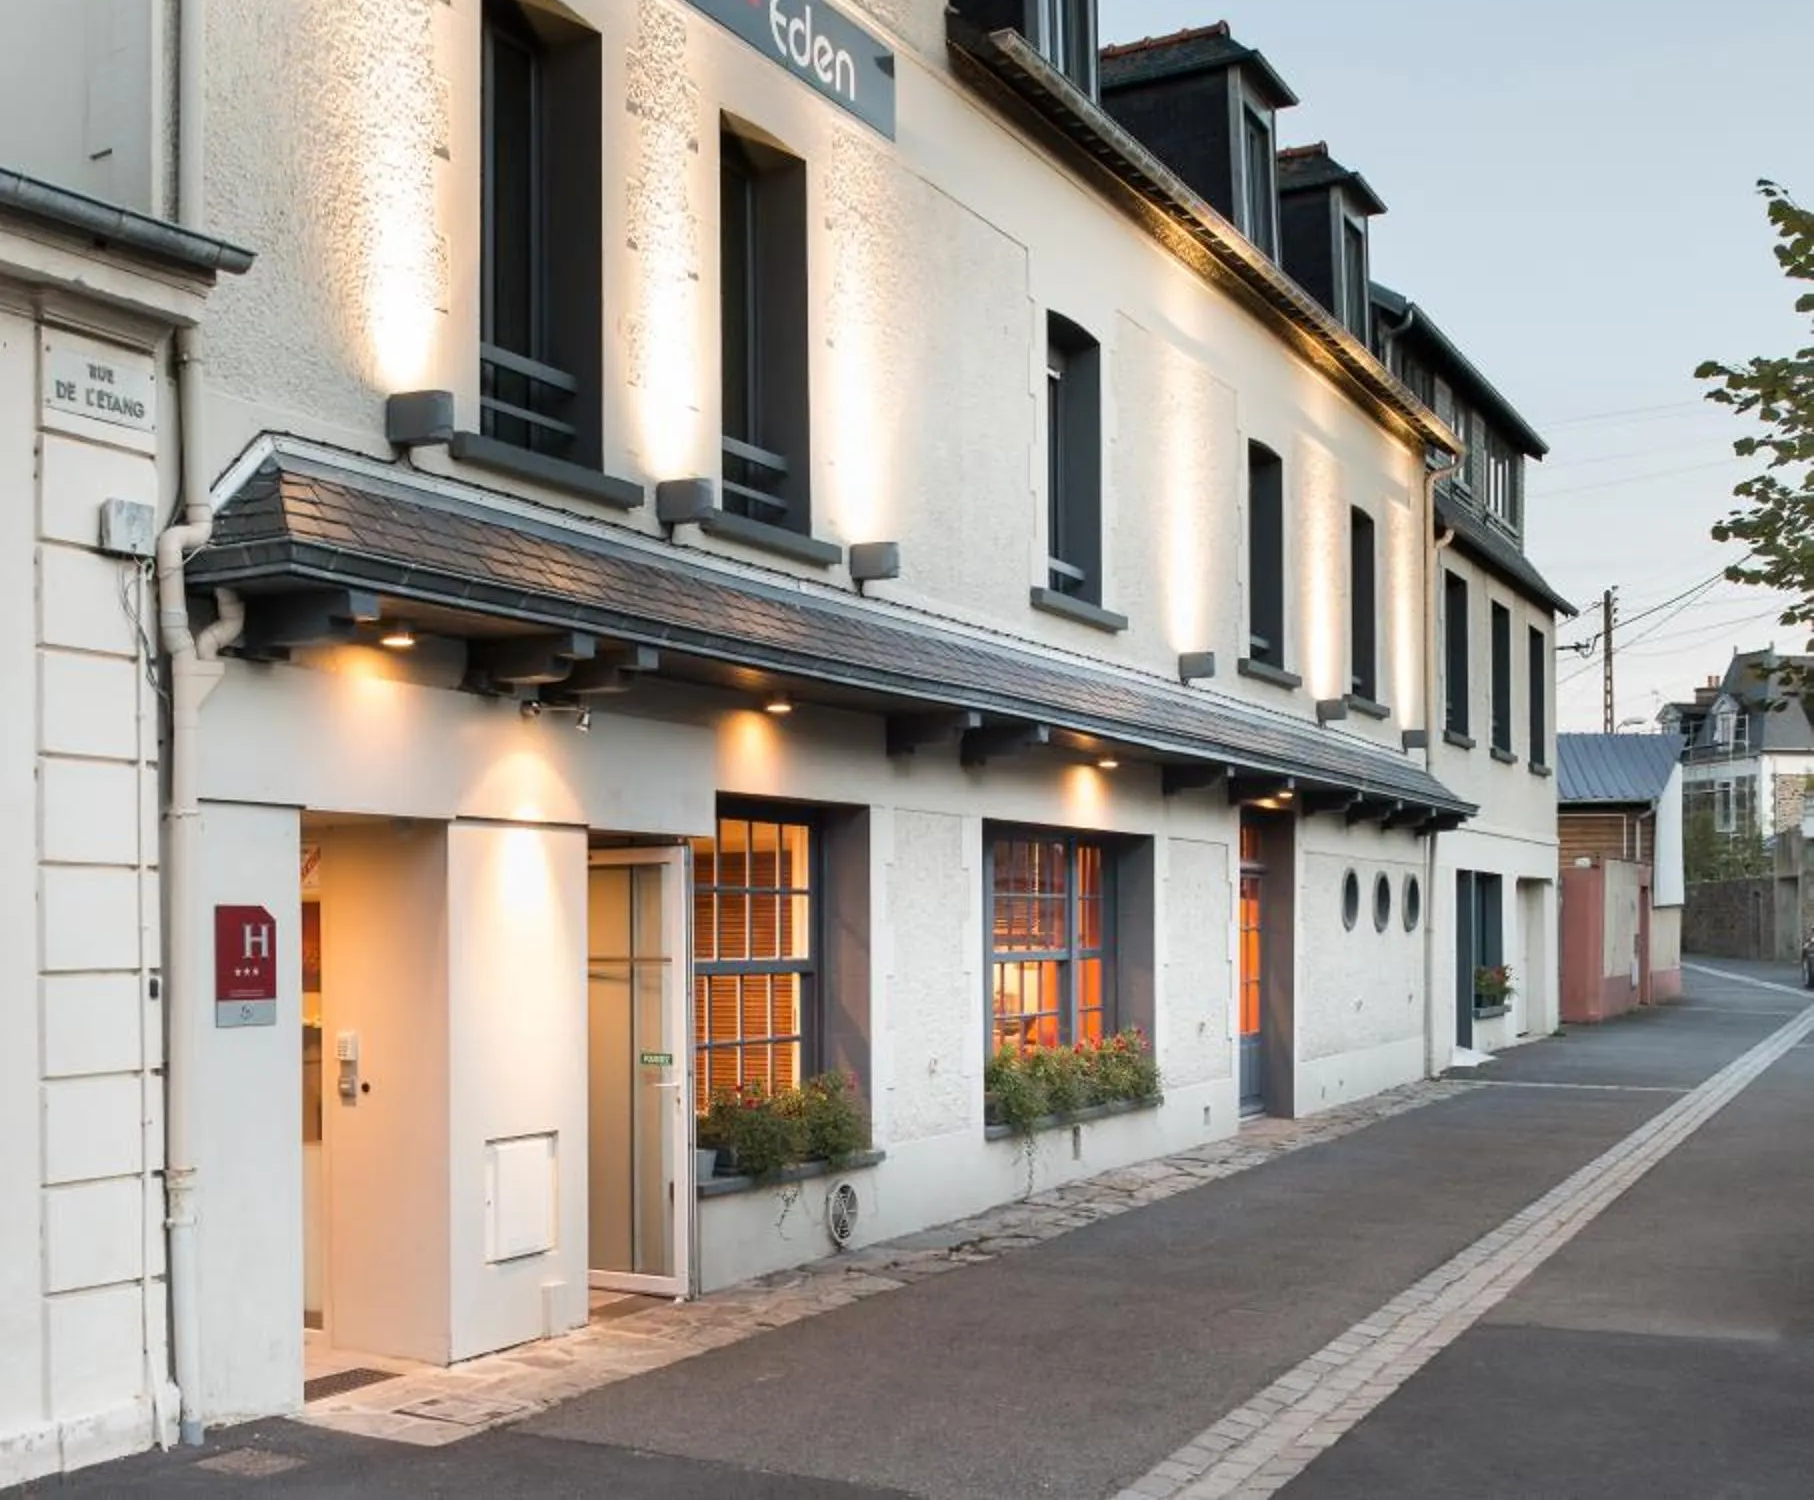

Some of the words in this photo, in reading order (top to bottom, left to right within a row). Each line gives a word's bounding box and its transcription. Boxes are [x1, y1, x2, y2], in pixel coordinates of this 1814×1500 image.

[87, 363, 114, 384] RUE
[55, 379, 77, 401] DE
[242, 923, 270, 959] H
